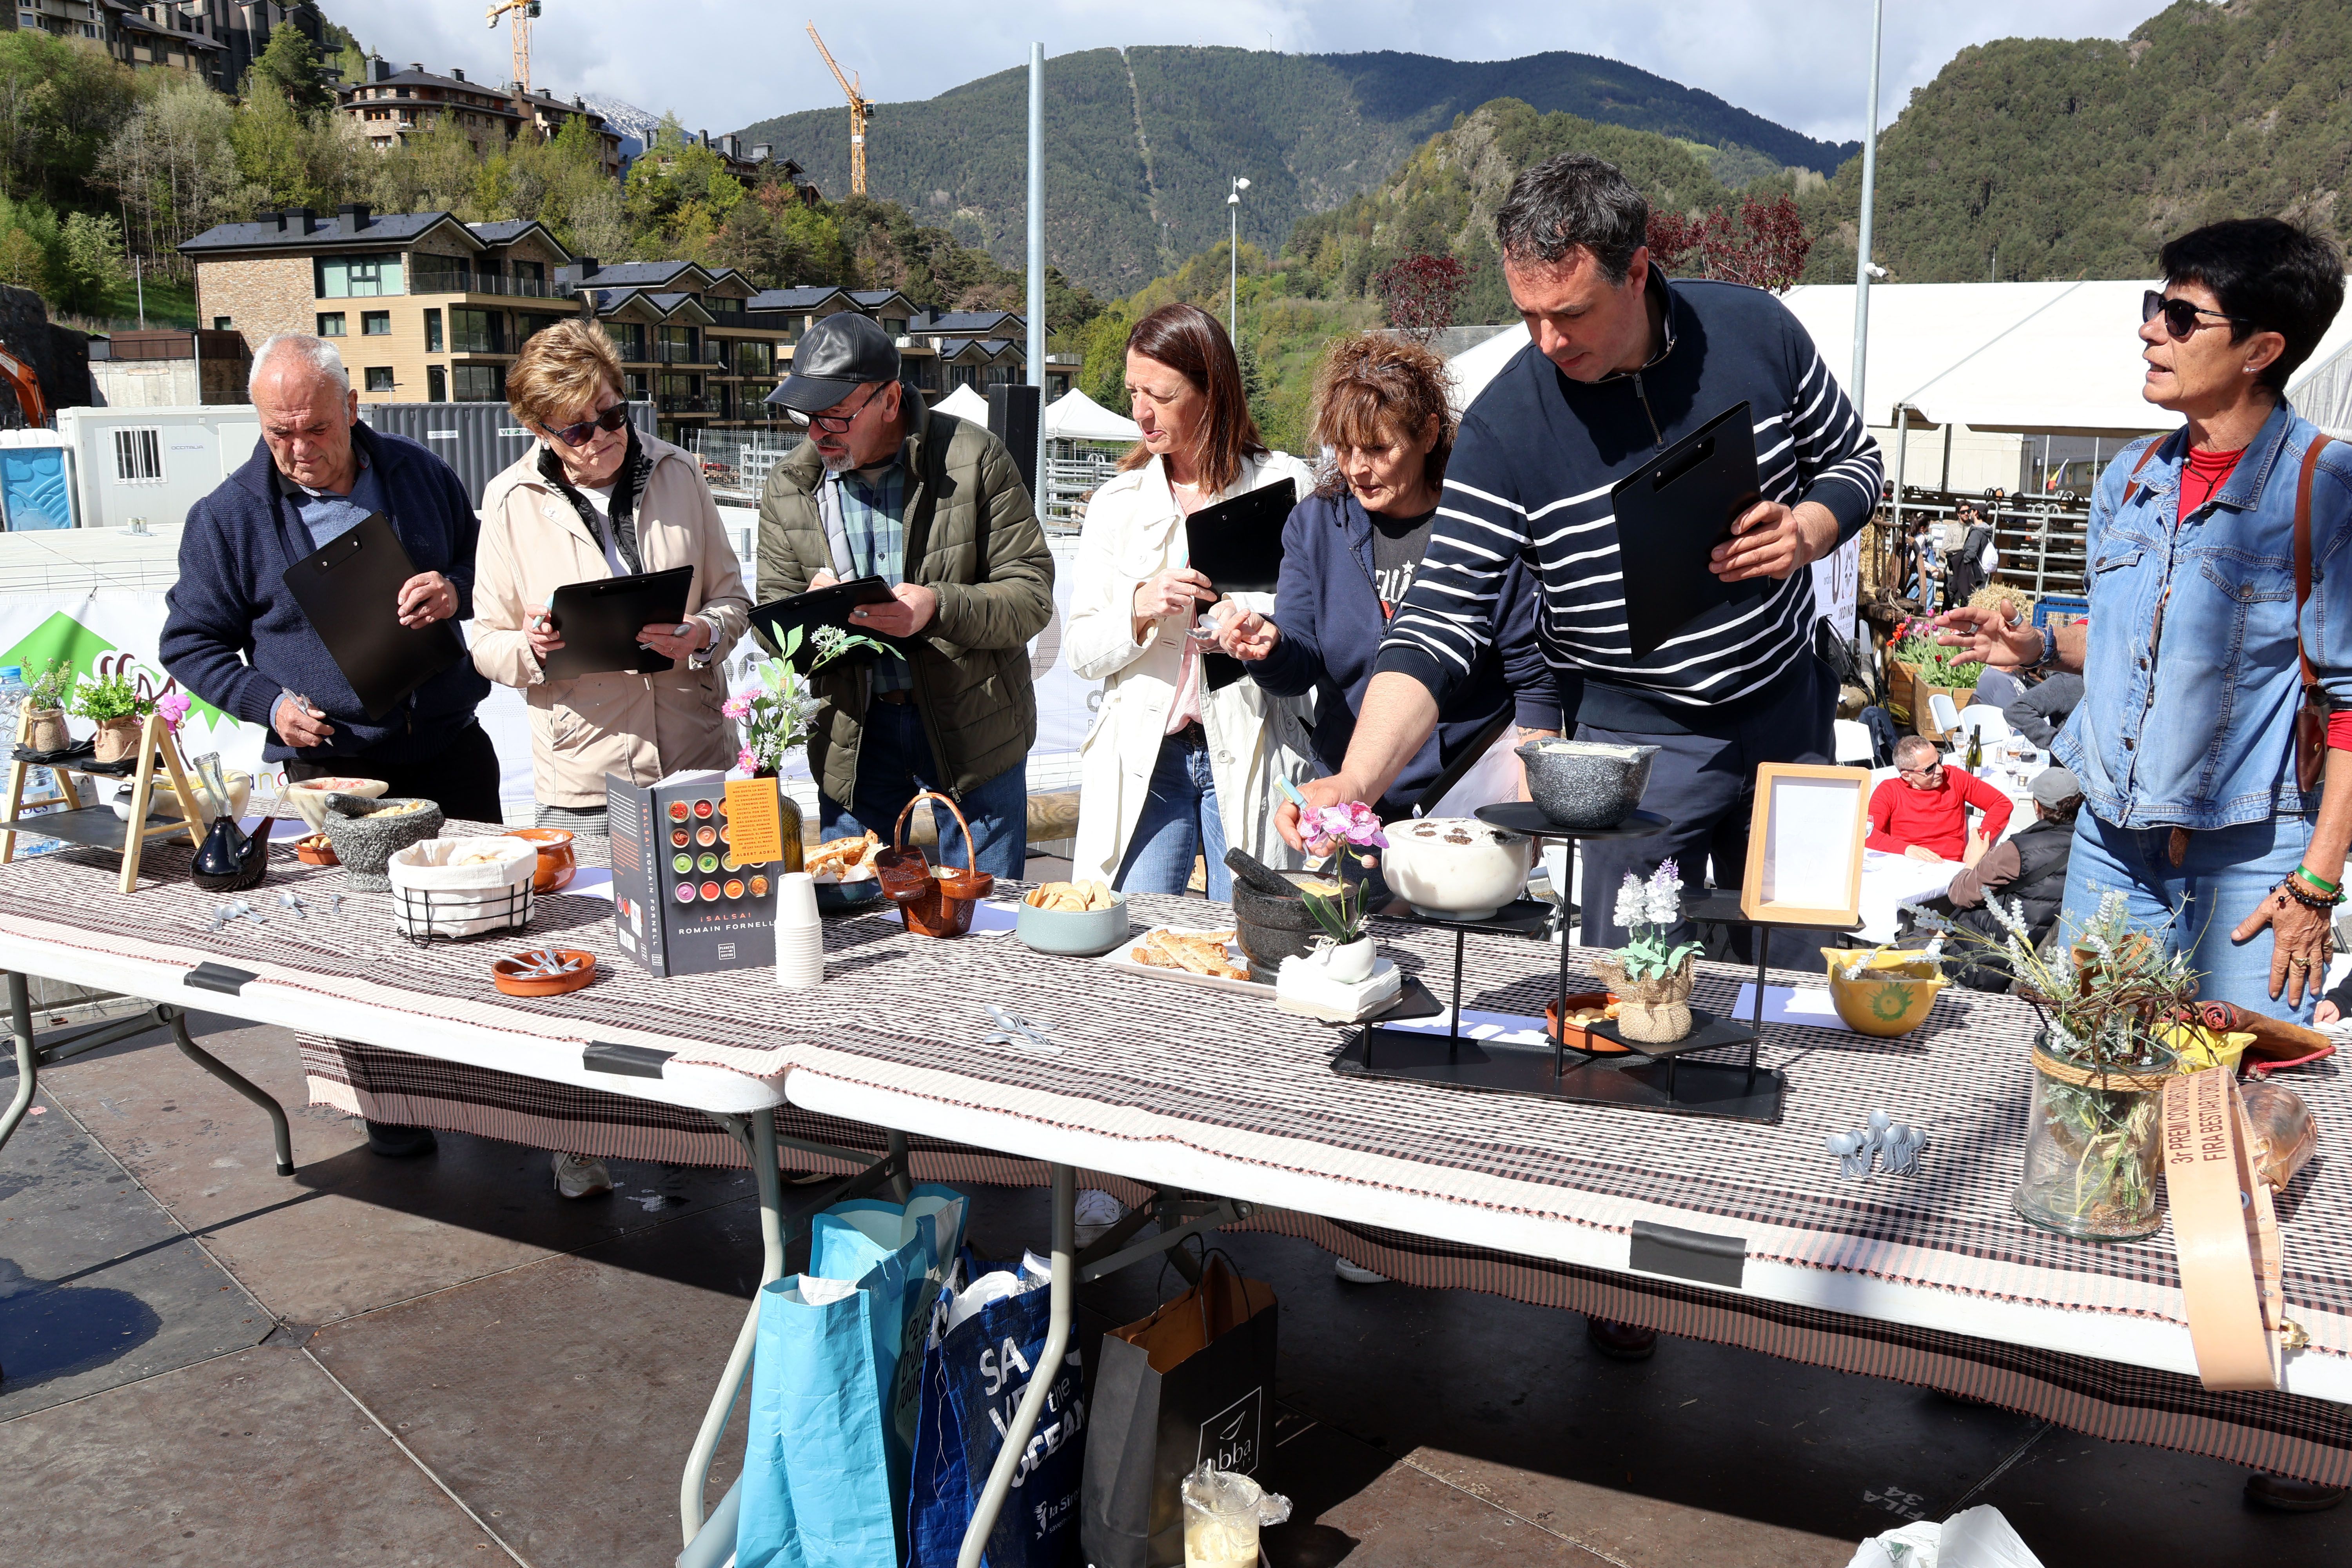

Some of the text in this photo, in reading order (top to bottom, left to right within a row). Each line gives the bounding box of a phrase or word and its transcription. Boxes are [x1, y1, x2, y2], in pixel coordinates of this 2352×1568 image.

[1838, 604, 1854, 622] ORDINO
[646, 853, 654, 893] ROMAIN
[650, 899, 658, 946] FORNELL
[679, 920, 774, 935] ROMAIN FORNELL
[700, 912, 751, 922] ¡SALSA!
[2197, 1076, 2220, 1100] D'ORDINO
[2167, 1091, 2190, 1121] CONCURS
[2198, 1099, 2223, 1133] BESTIAR
[2167, 1121, 2192, 1150] PREMI
[2201, 1133, 2227, 1161] FIRA
[2171, 1152, 2194, 1164] 3r
[980, 1336, 1030, 1396] SA
[1048, 1377, 1070, 1412] the
[1214, 1439, 1251, 1471] bba
[1049, 1487, 1080, 1519] la Sire
[1863, 1490, 1926, 1521] FILA
[1884, 1486, 1924, 1506] 34
